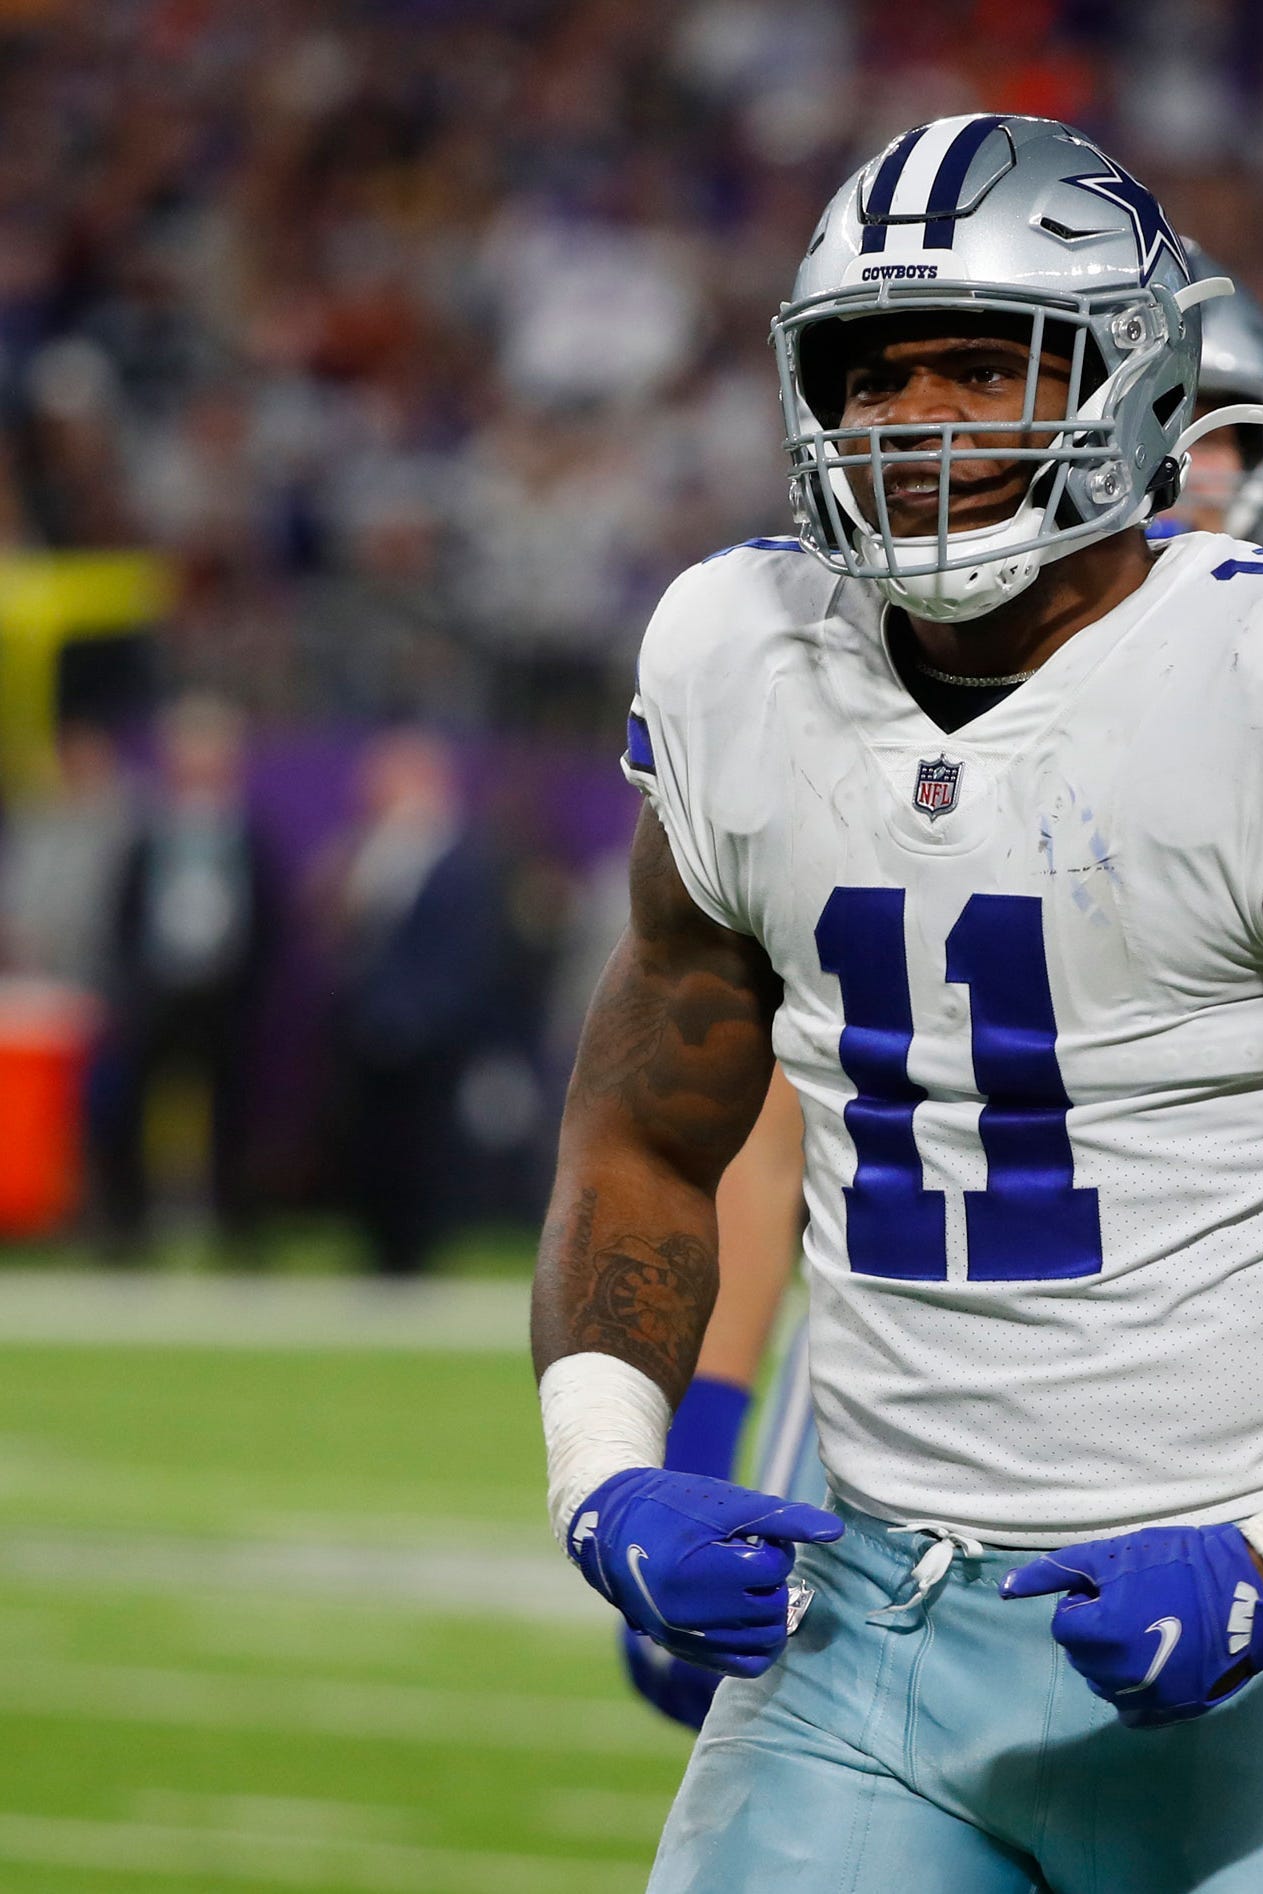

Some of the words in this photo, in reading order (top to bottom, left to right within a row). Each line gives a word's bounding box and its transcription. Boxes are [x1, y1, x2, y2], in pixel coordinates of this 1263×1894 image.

[862, 265, 938, 281] COWBOYS
[919, 782, 950, 807] NFL
[814, 886, 1102, 1281] 11
